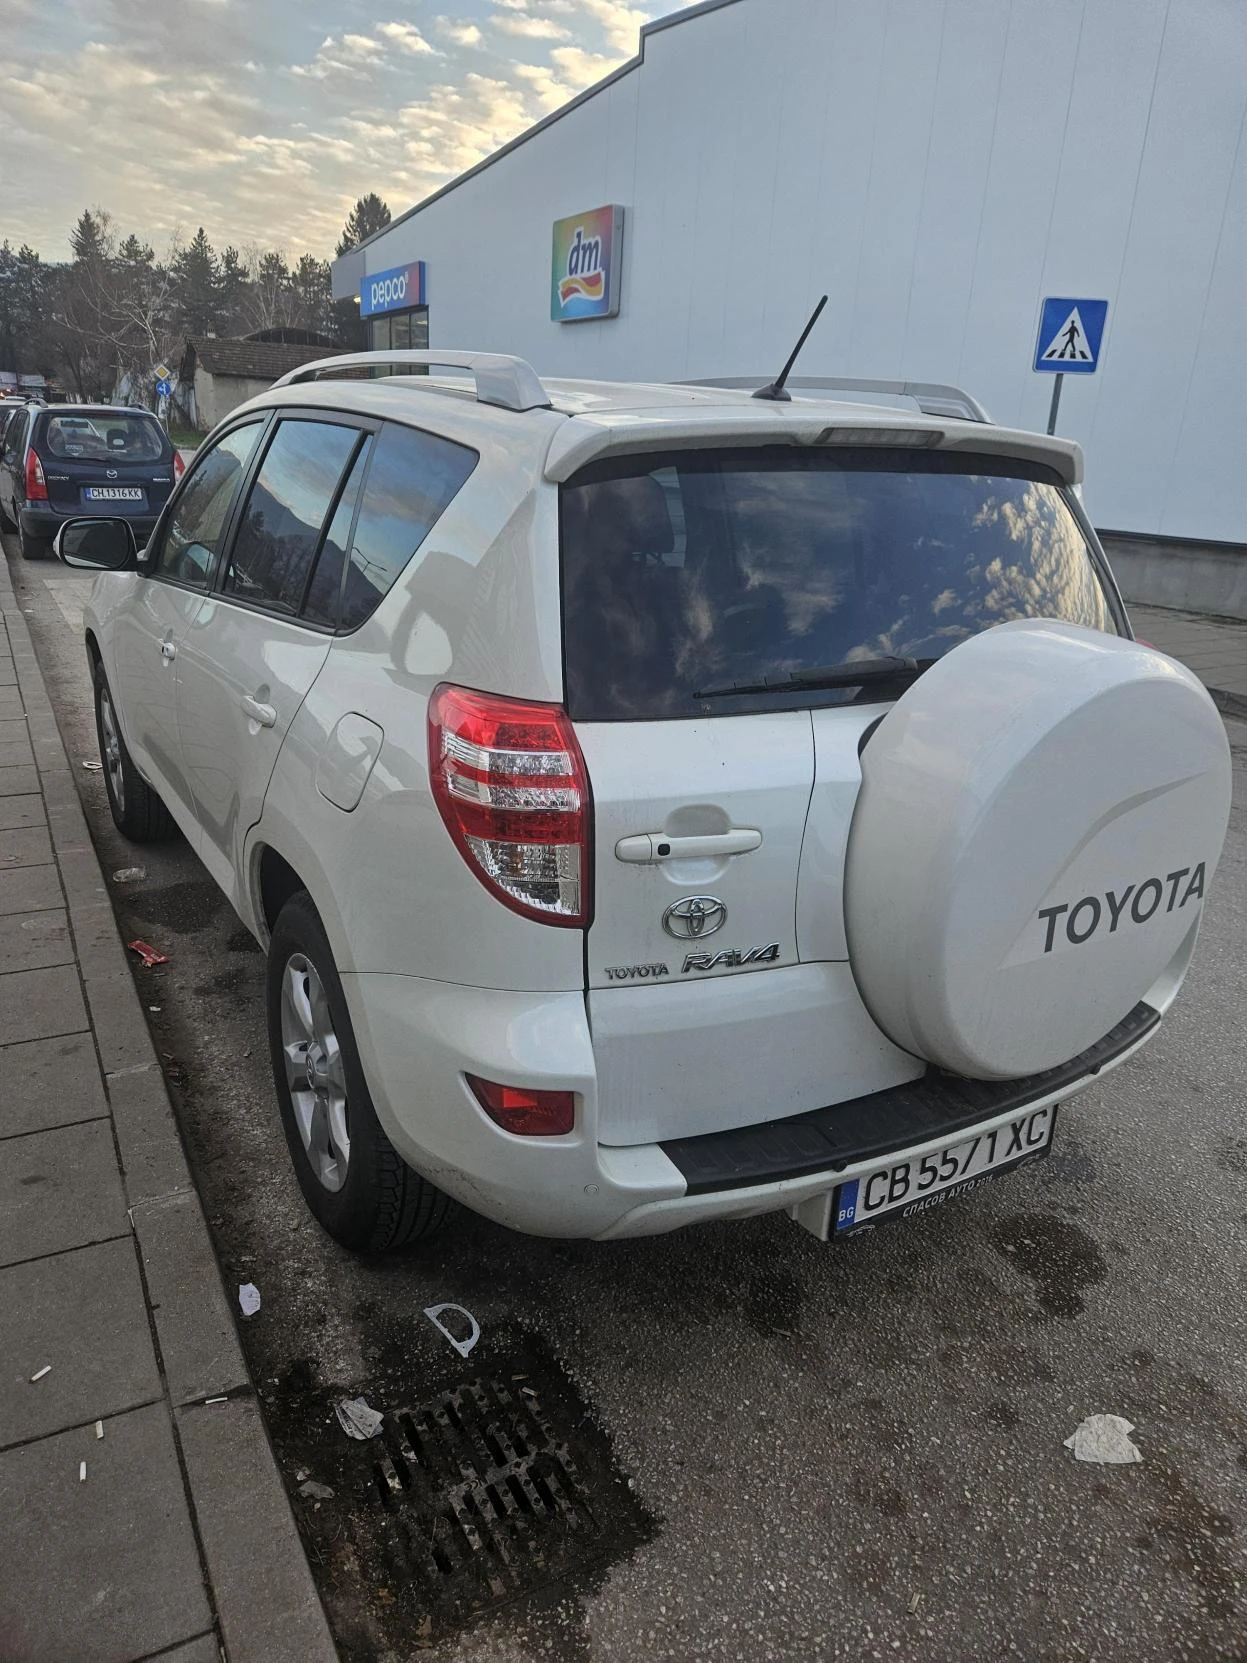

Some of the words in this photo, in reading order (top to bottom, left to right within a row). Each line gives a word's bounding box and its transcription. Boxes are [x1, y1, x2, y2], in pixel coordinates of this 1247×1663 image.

[568, 230, 600, 277] dm
[1038, 862, 1206, 953] TOYOTA
[605, 963, 669, 980] TOYOTA
[681, 942, 780, 973] RAV4
[918, 1131, 997, 1190] 5571
[838, 1206, 855, 1222] BG
[902, 1194, 946, 1218] СПАСОВ
[947, 1182, 975, 1199] АУТО
